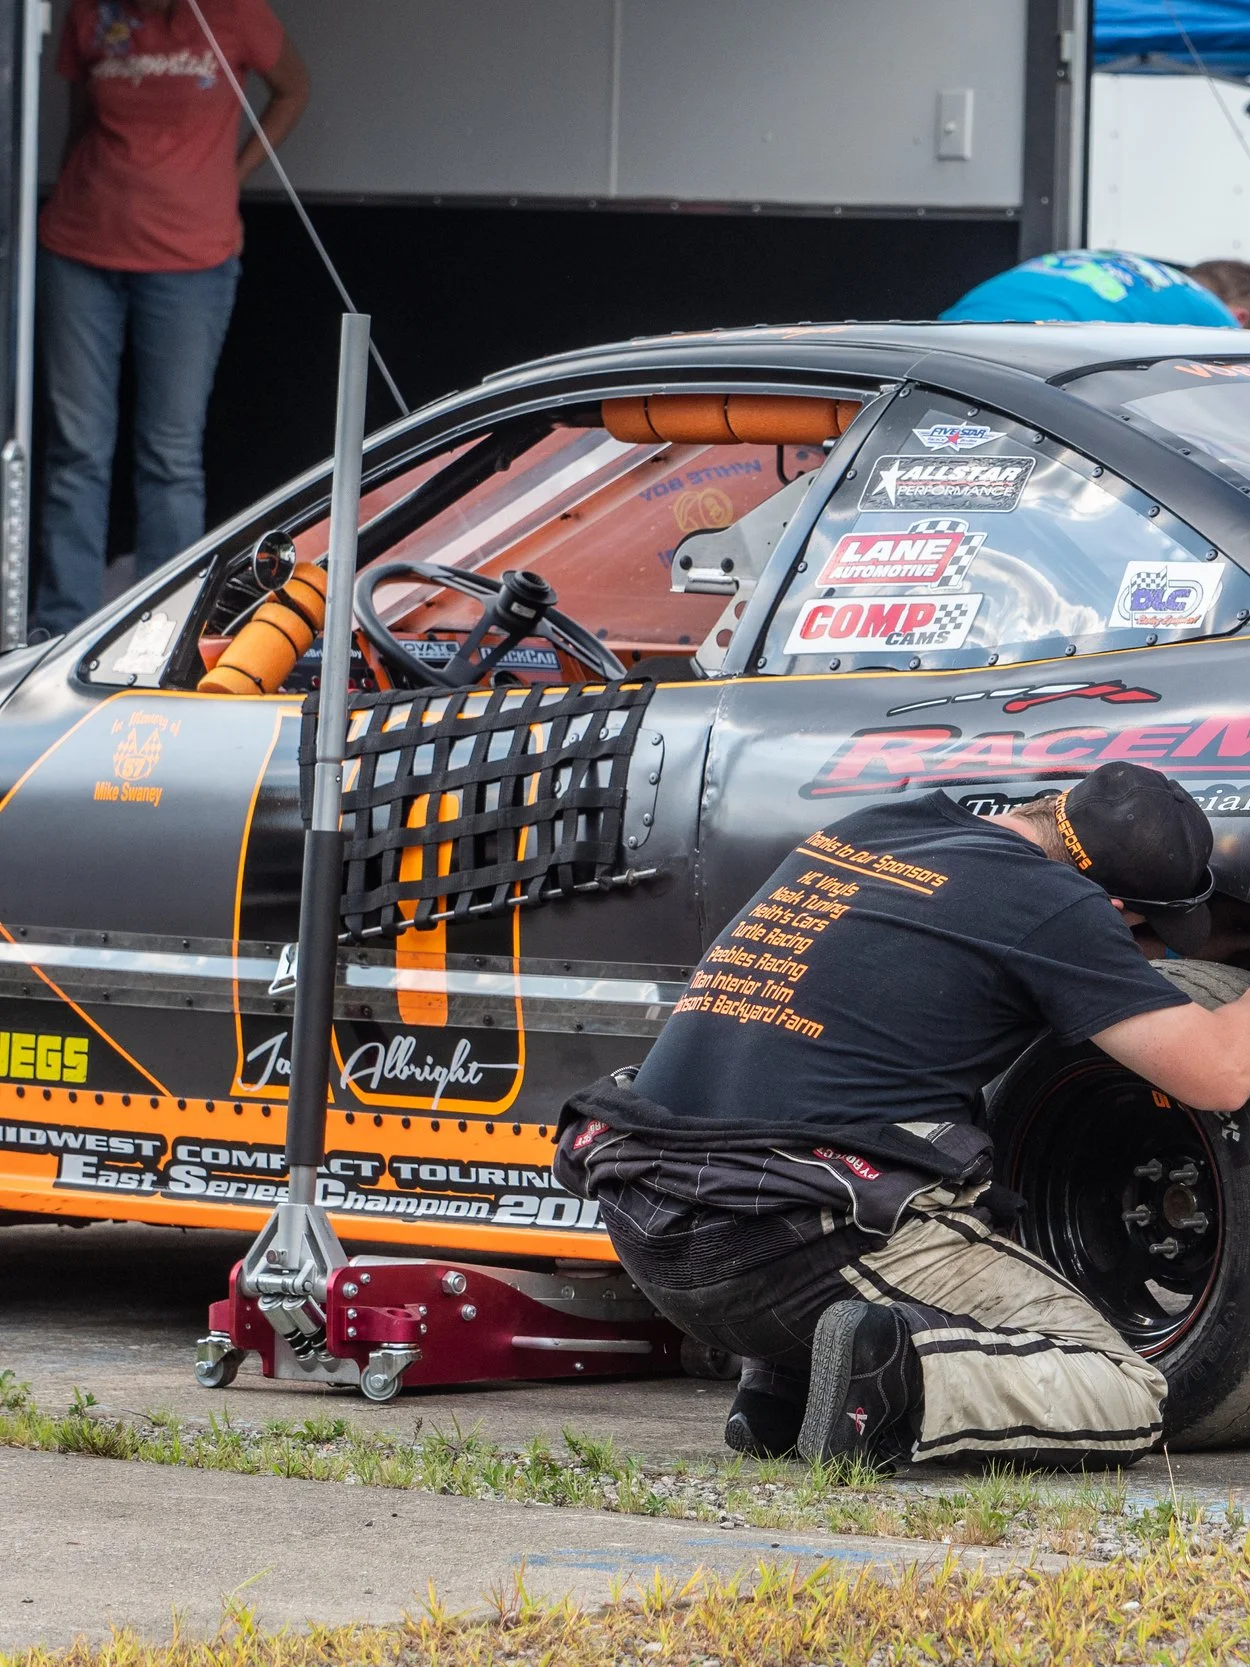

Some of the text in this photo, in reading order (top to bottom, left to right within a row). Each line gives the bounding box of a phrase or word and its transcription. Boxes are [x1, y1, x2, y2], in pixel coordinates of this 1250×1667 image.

[930, 427, 987, 438] FIVE STAR
[901, 465, 1022, 481] ALLSTAR
[897, 485, 1015, 497] PERFORMANCE
[840, 538, 953, 563] LANE
[829, 564, 940, 579] AUTOMOTIVE
[800, 603, 936, 640] COMP
[885, 630, 950, 646] CAMS
[479, 647, 558, 665] QICKCAR
[93, 781, 163, 808] Mike Swaney
[804, 830, 948, 888] Thanks to Our Sponsors
[797, 871, 860, 898] HC Vinyls
[768, 886, 852, 919] Naak Tuning
[749, 904, 830, 932] Keith's Cars
[731, 921, 814, 955] Turtle Racing
[706, 945, 809, 983] Peebles Racing
[690, 970, 794, 1003] Titan Interior Trim
[712, 994, 780, 1023] Backyard
[775, 1006, 824, 1039] Farm
[340, 1034, 524, 1110] Albright
[0, 1125, 563, 1191] IDWEST COMPCT TOURIN
[60, 1153, 608, 1229] East Series Champion 201
